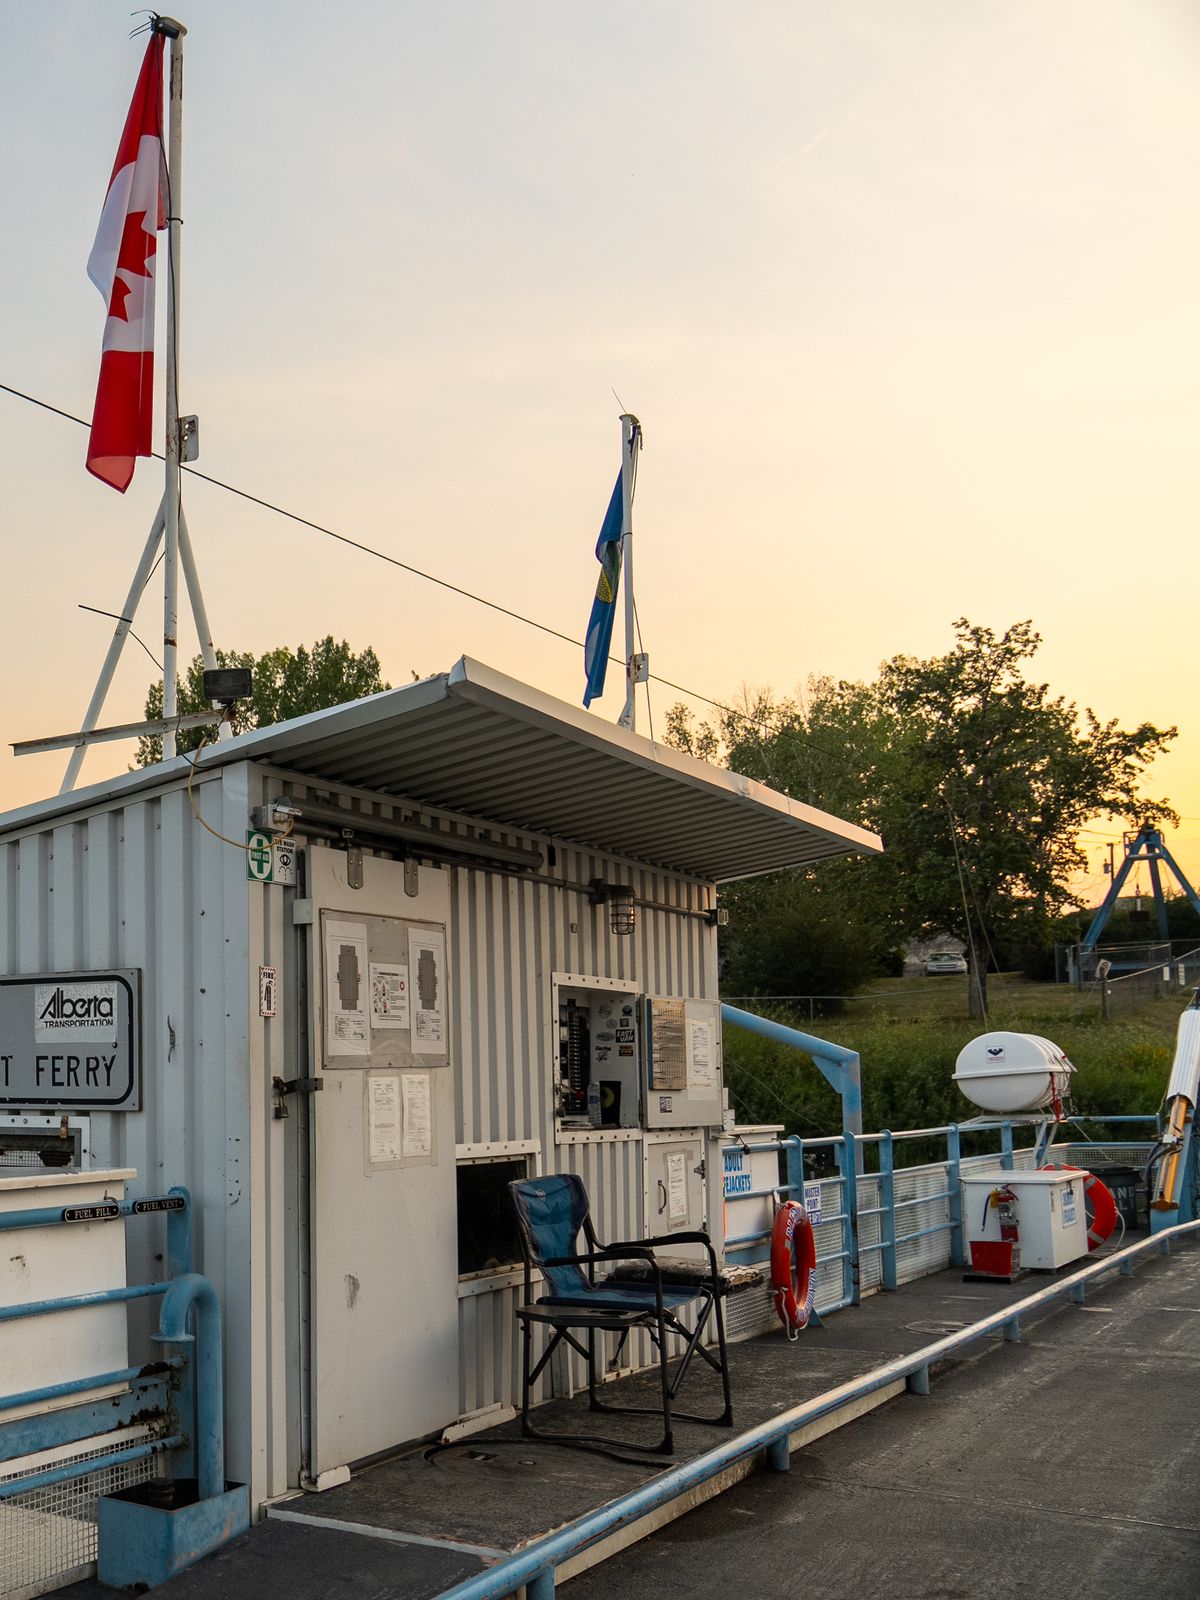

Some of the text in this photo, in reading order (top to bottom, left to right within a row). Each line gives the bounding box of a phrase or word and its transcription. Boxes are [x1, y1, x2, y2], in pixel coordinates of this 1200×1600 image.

[276, 846, 294, 854] STATION
[283, 840, 295, 848] WASH
[263, 971, 274, 980] FIRE
[39, 987, 114, 1020] Alberta
[43, 1019, 114, 1028] TRANSPORTATION
[35, 1053, 117, 1087] FERRY
[724, 1153, 743, 1173] ADULT
[805, 1186, 820, 1198] MUSTER
[142, 1199, 179, 1211] FUEL VENT
[807, 1198, 819, 1210] POINT
[74, 1207, 112, 1219] FUEL FILL
